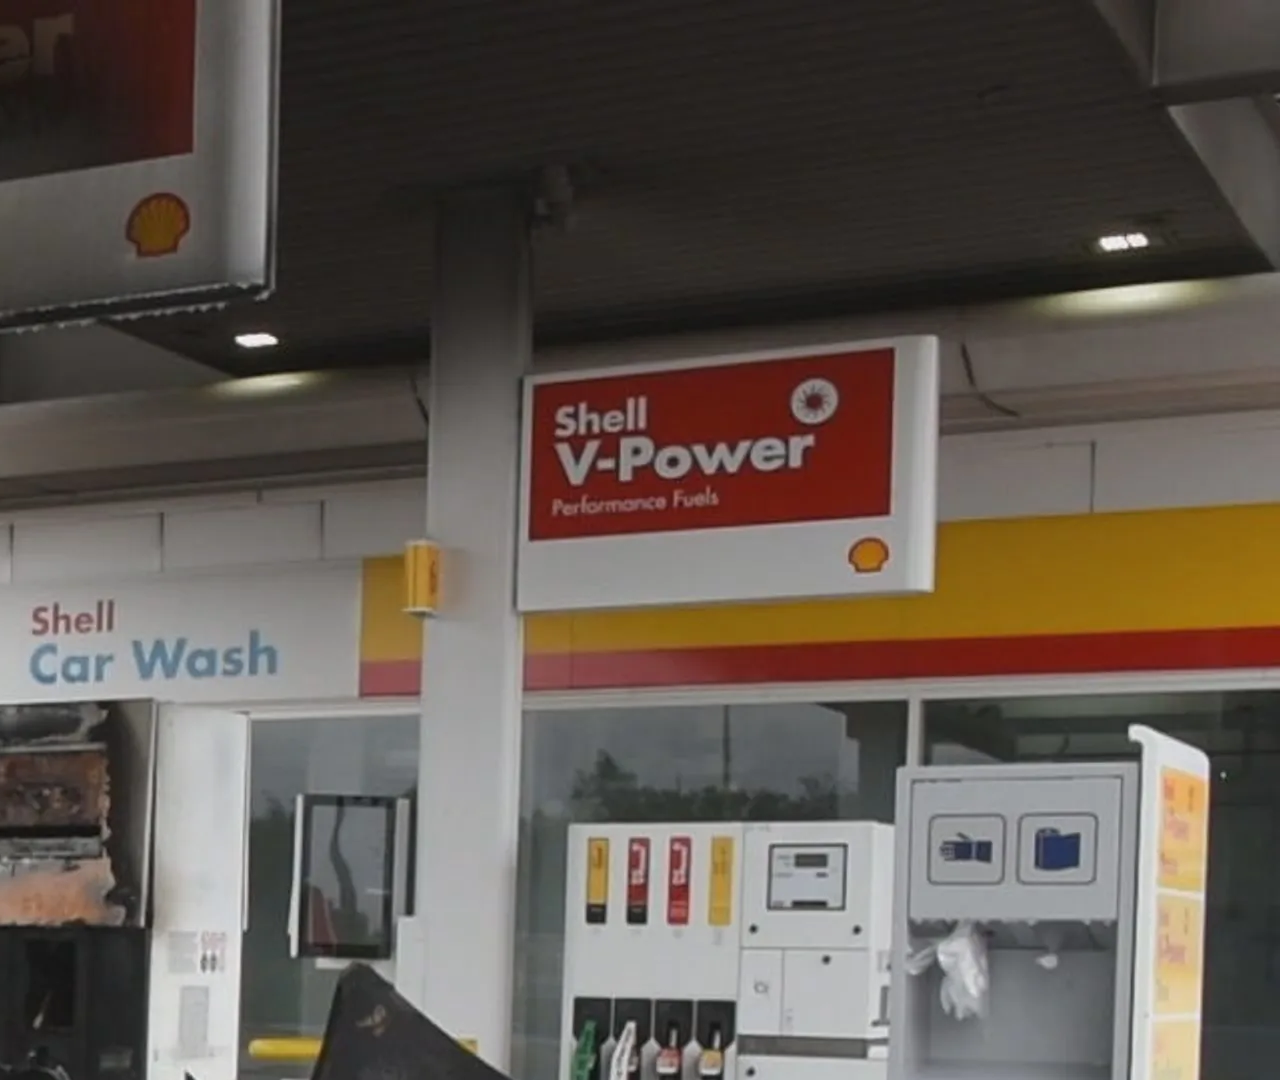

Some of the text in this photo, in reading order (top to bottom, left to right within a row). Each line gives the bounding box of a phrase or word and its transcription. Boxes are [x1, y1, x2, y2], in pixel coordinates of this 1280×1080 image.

[554, 396, 647, 438] Shell
[554, 433, 815, 486] V-Power
[551, 485, 719, 517] Performance Fuels
[30, 599, 115, 636] Shell
[28, 628, 279, 685] Car Wash
